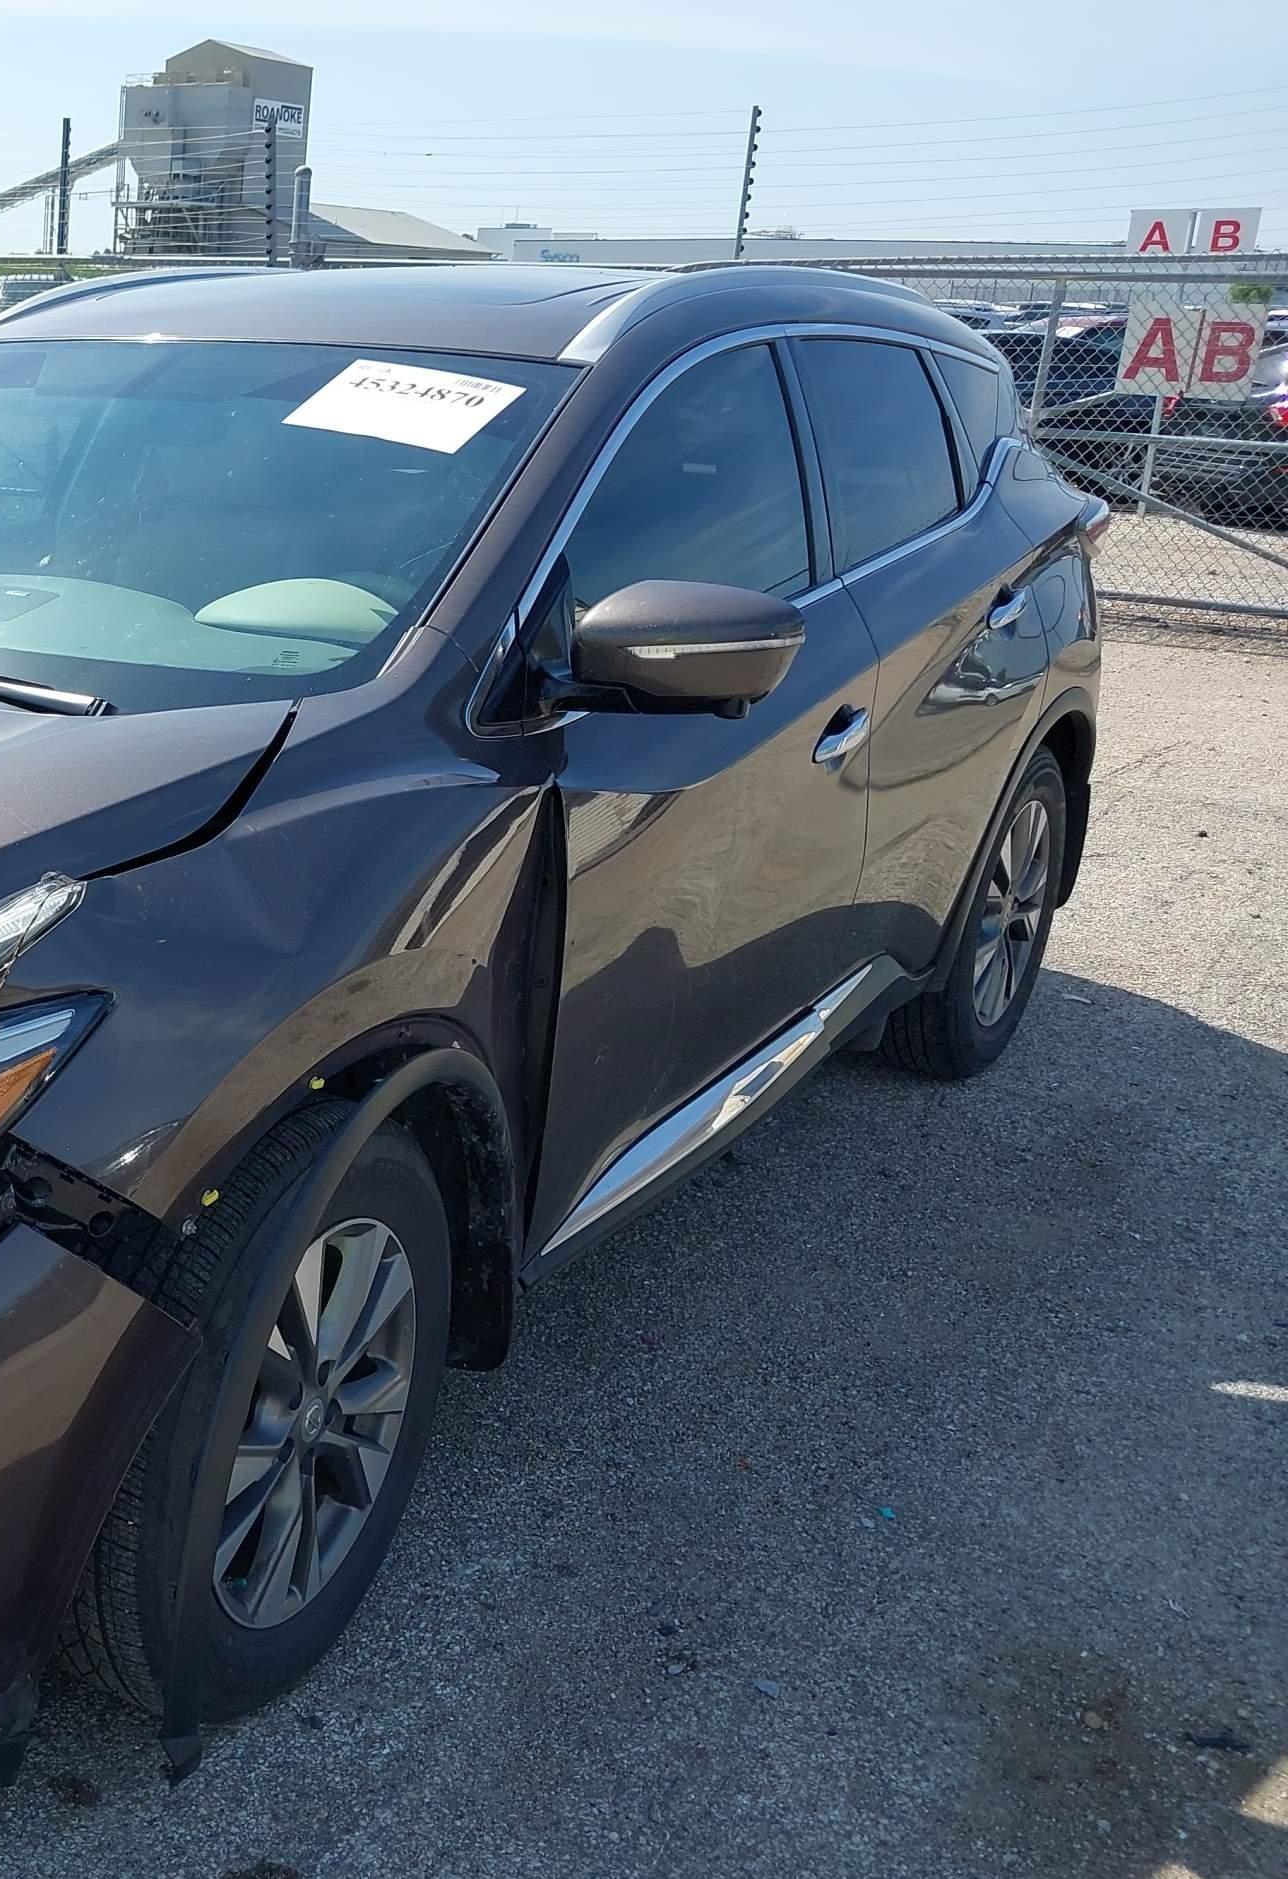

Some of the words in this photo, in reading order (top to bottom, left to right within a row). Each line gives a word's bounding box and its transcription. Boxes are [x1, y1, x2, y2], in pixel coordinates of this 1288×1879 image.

[255, 104, 302, 124] ROANOKE
[1139, 220, 1170, 252] A
[1210, 220, 1241, 252] B
[1122, 318, 1179, 382] A
[1199, 321, 1255, 383] B
[349, 377, 485, 408] 45324870
